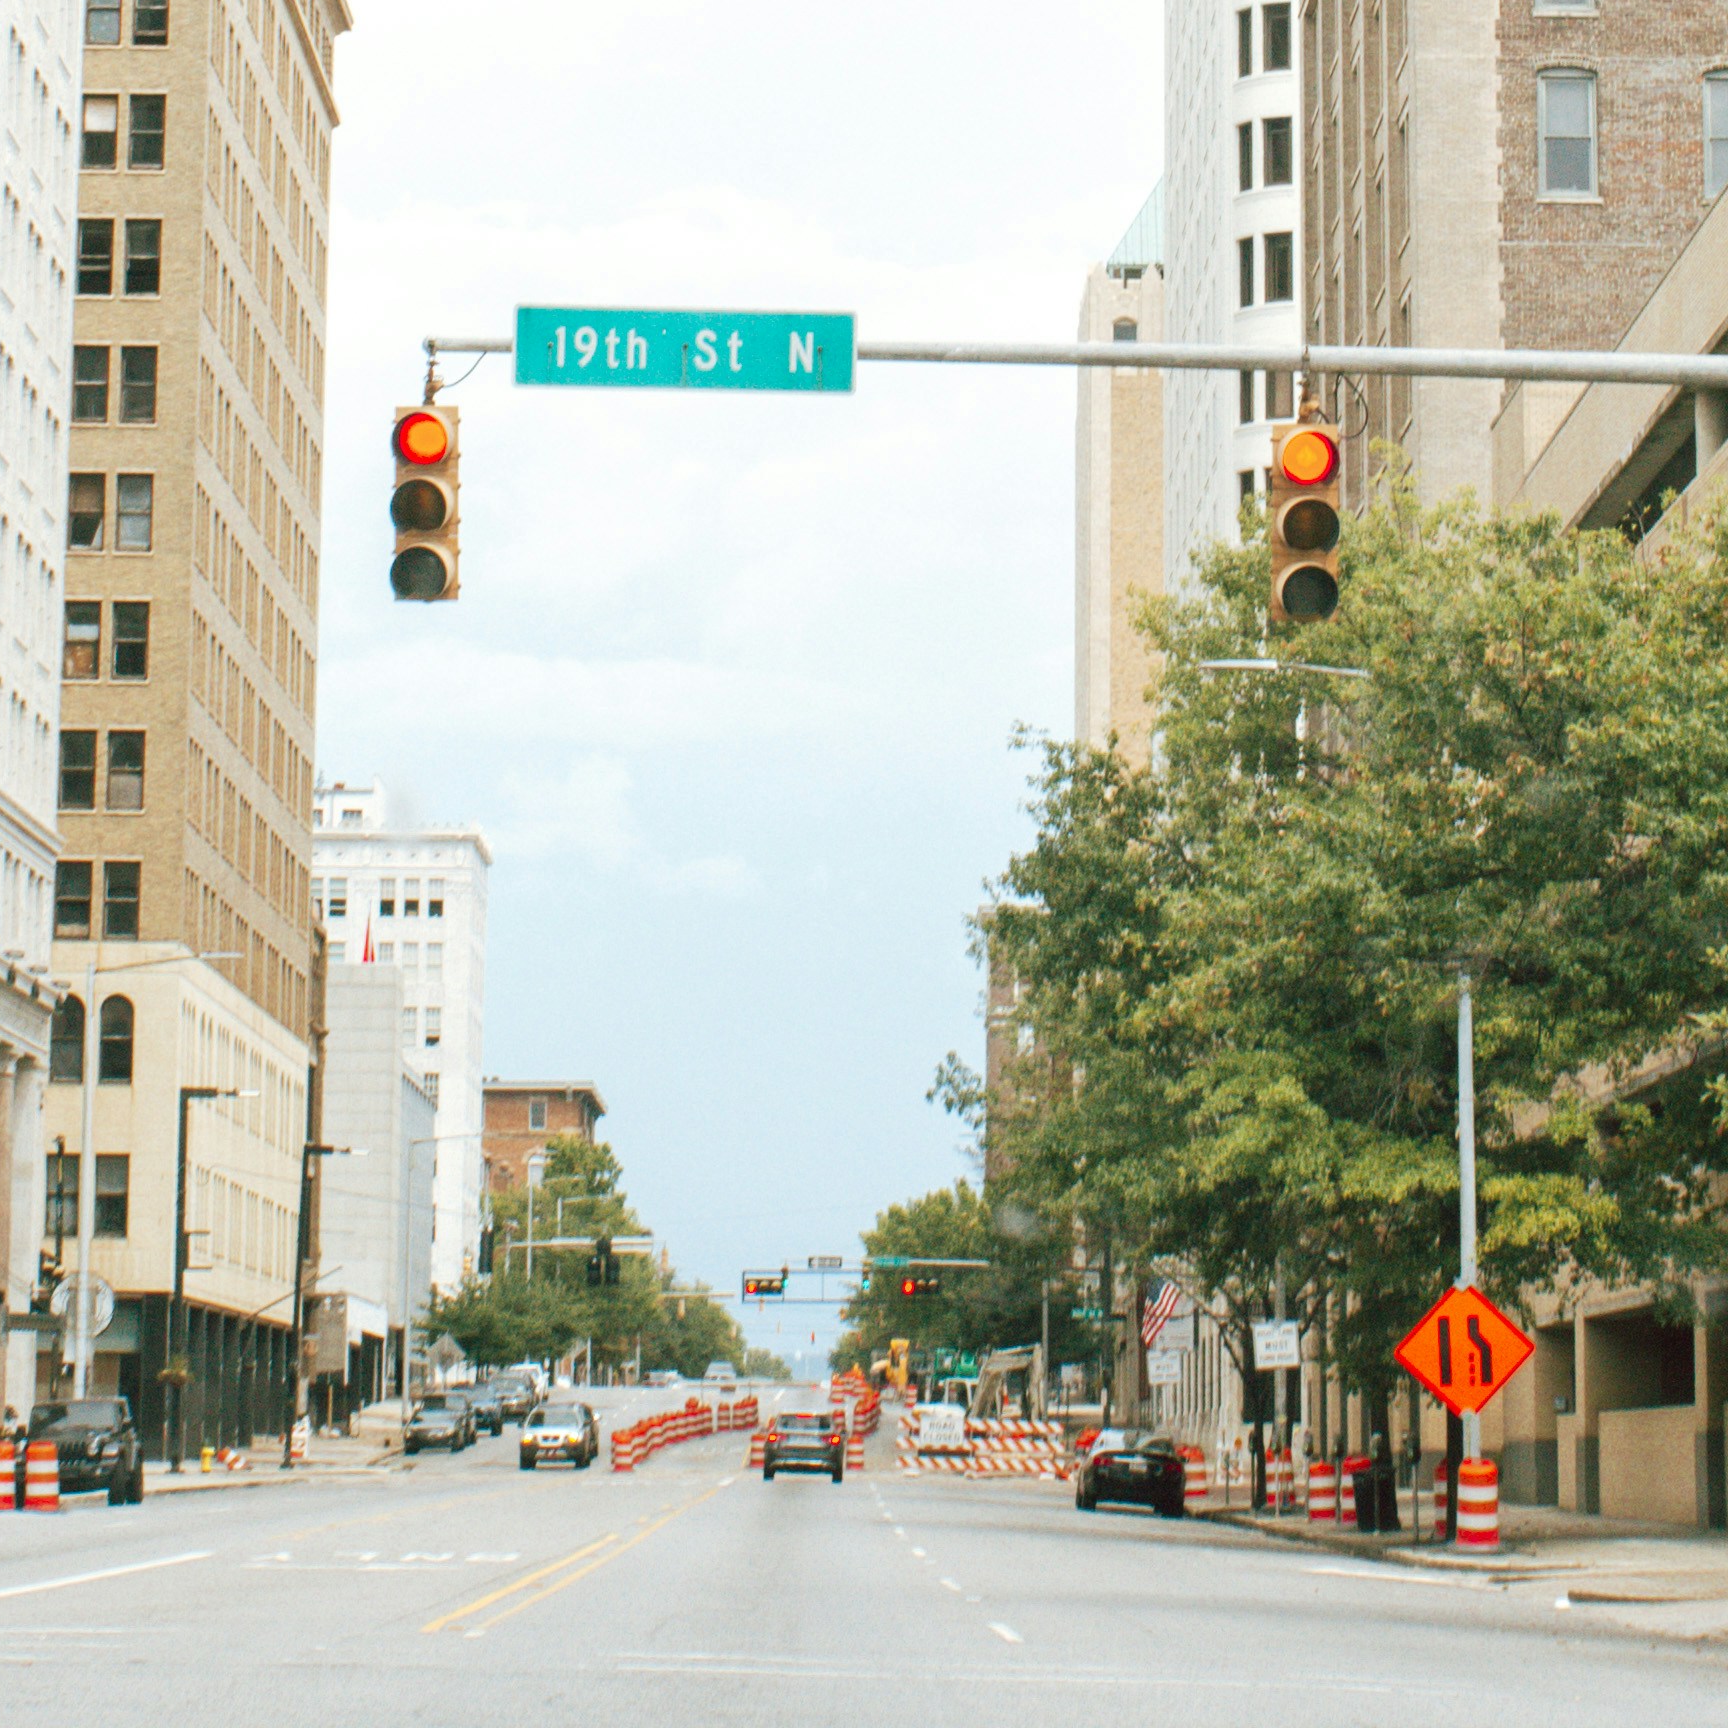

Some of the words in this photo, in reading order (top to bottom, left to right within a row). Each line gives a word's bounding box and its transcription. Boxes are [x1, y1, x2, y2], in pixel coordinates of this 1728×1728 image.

[555, 325, 648, 370] 19th
[693, 329, 744, 372] St
[788, 330, 815, 374] N
